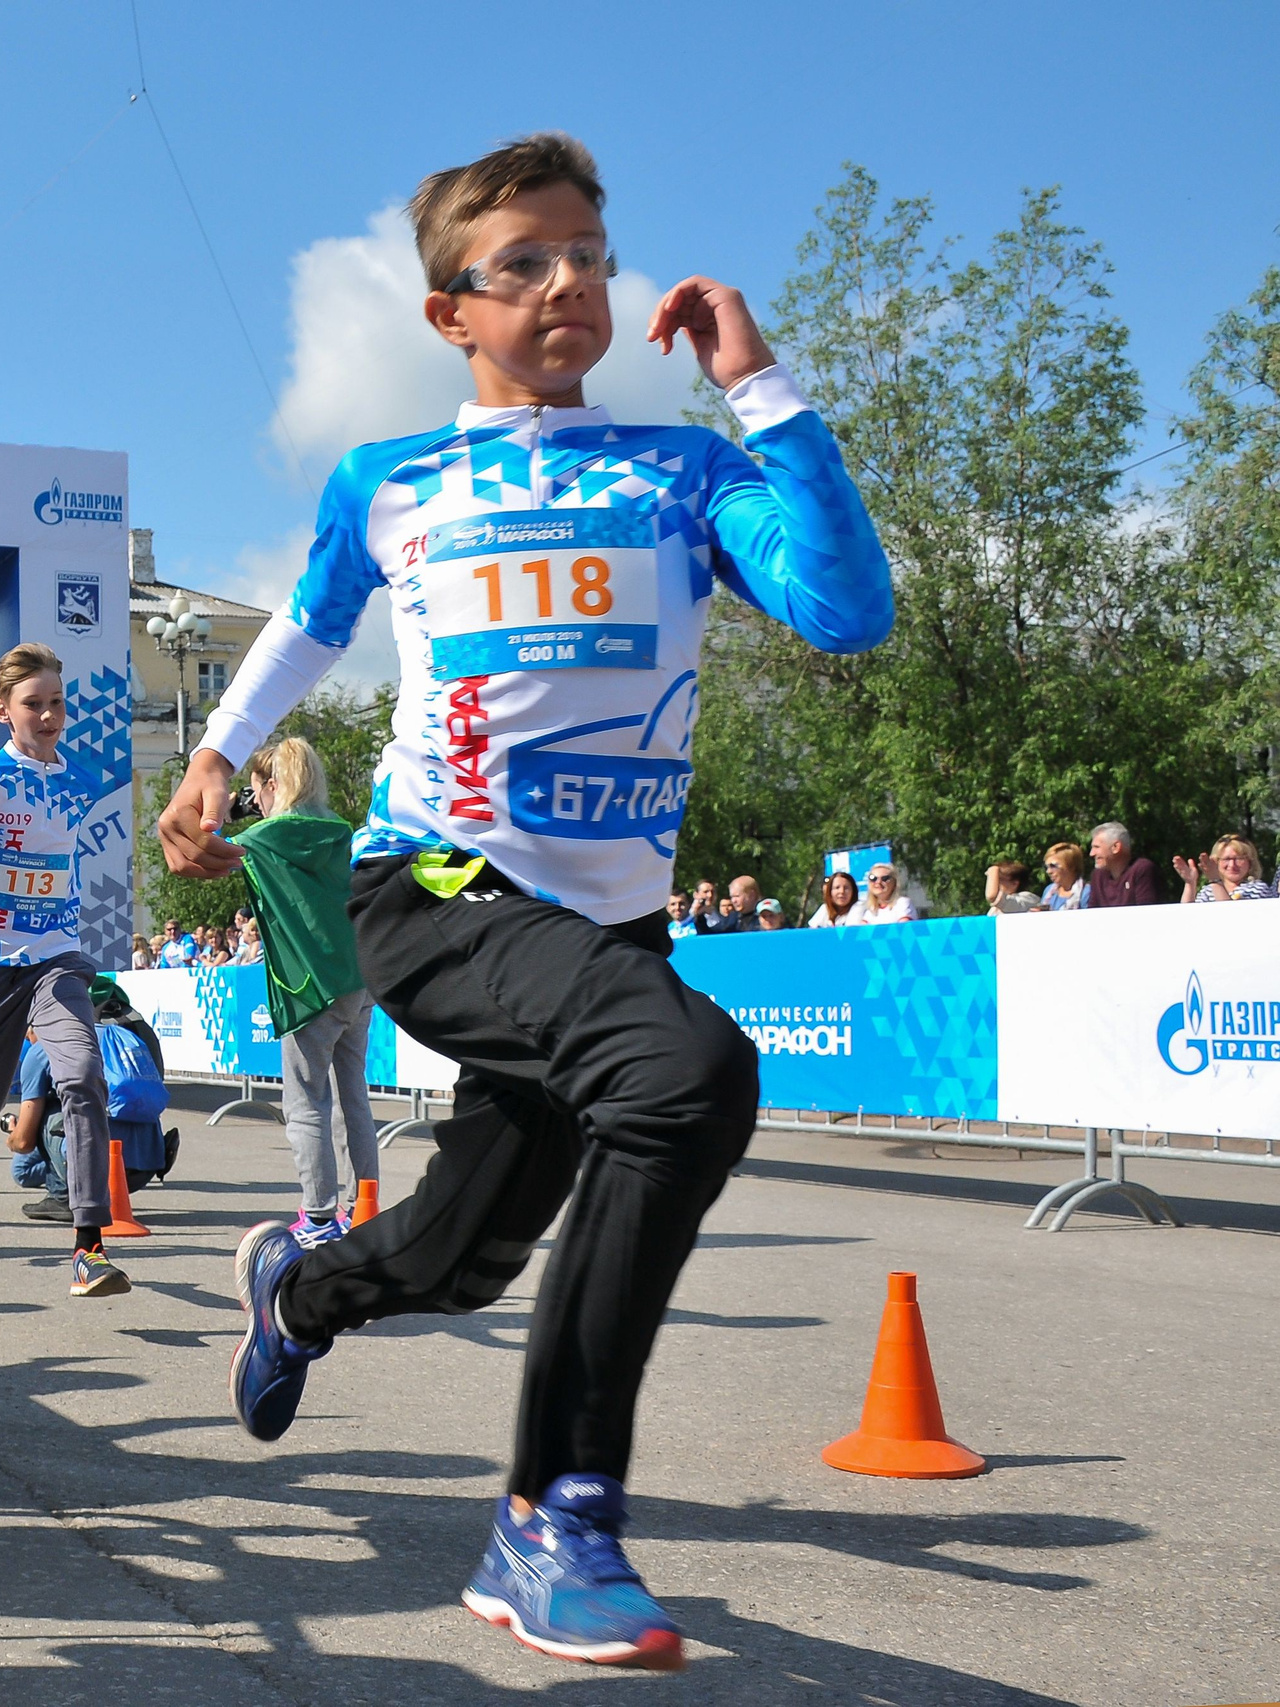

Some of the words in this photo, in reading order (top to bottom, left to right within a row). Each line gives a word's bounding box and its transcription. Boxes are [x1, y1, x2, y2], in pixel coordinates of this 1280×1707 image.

[64, 491, 123, 511] ГАЗПРОМ
[65, 509, 122, 522] ТРАНСГАЗ
[497, 528, 574, 543] МАРАФОН
[473, 556, 613, 622] 118
[517, 645, 554, 662] 600
[556, 645, 576, 660] М
[447, 674, 494, 822] МАРА
[552, 773, 616, 822] 67
[77, 810, 127, 858] АРТ
[6, 870, 54, 895] 113
[16, 903, 29, 911] 600
[728, 1002, 852, 1022] АРКТИЧЕСКИЙ
[1210, 1001, 1280, 1036] ГАЗПР
[740, 1025, 852, 1056] АРАФОН
[1213, 1042, 1280, 1059] ТРАНС
